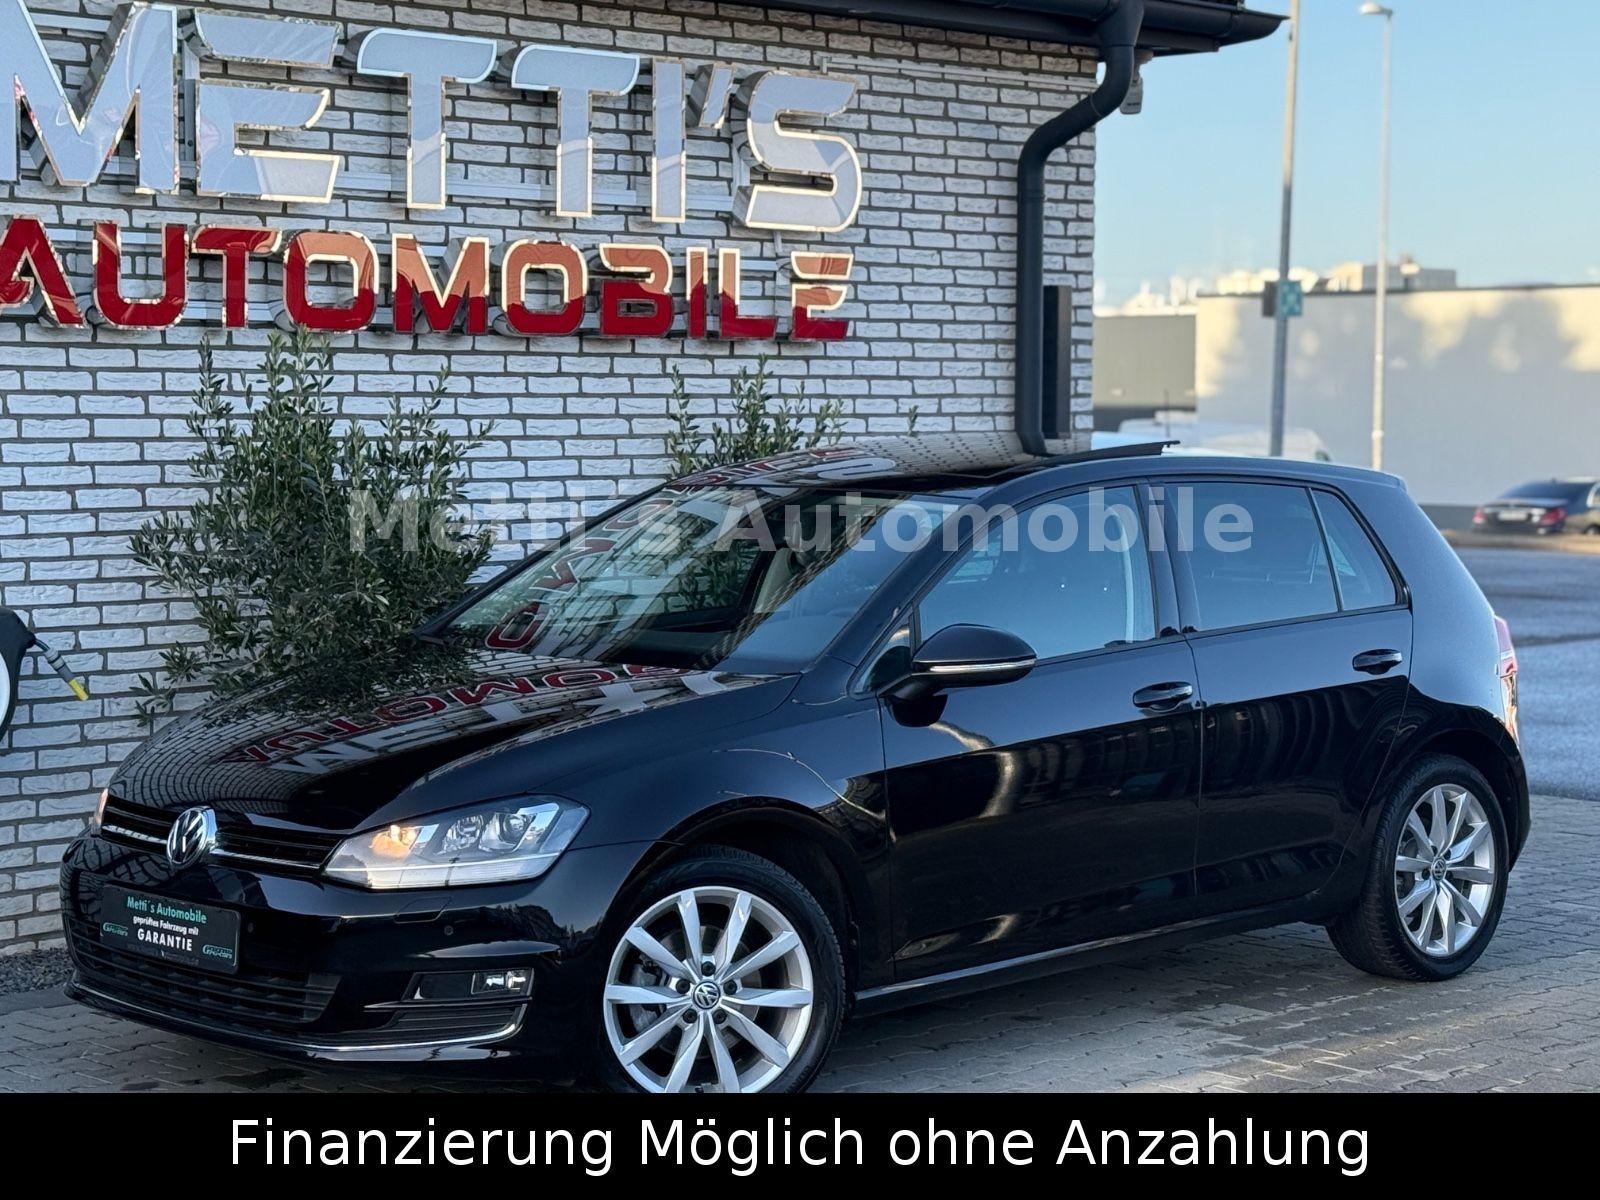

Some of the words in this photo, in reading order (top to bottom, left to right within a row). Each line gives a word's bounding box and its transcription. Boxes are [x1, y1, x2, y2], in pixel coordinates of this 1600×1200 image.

[0, 213, 854, 341] AUTOMOBILE
[156, 903, 207, 924] Automobile
[133, 915, 159, 927] geprüftes
[160, 920, 187, 935] Fahrzeug
[188, 926, 199, 936] mit
[137, 928, 193, 951] GARANTIE
